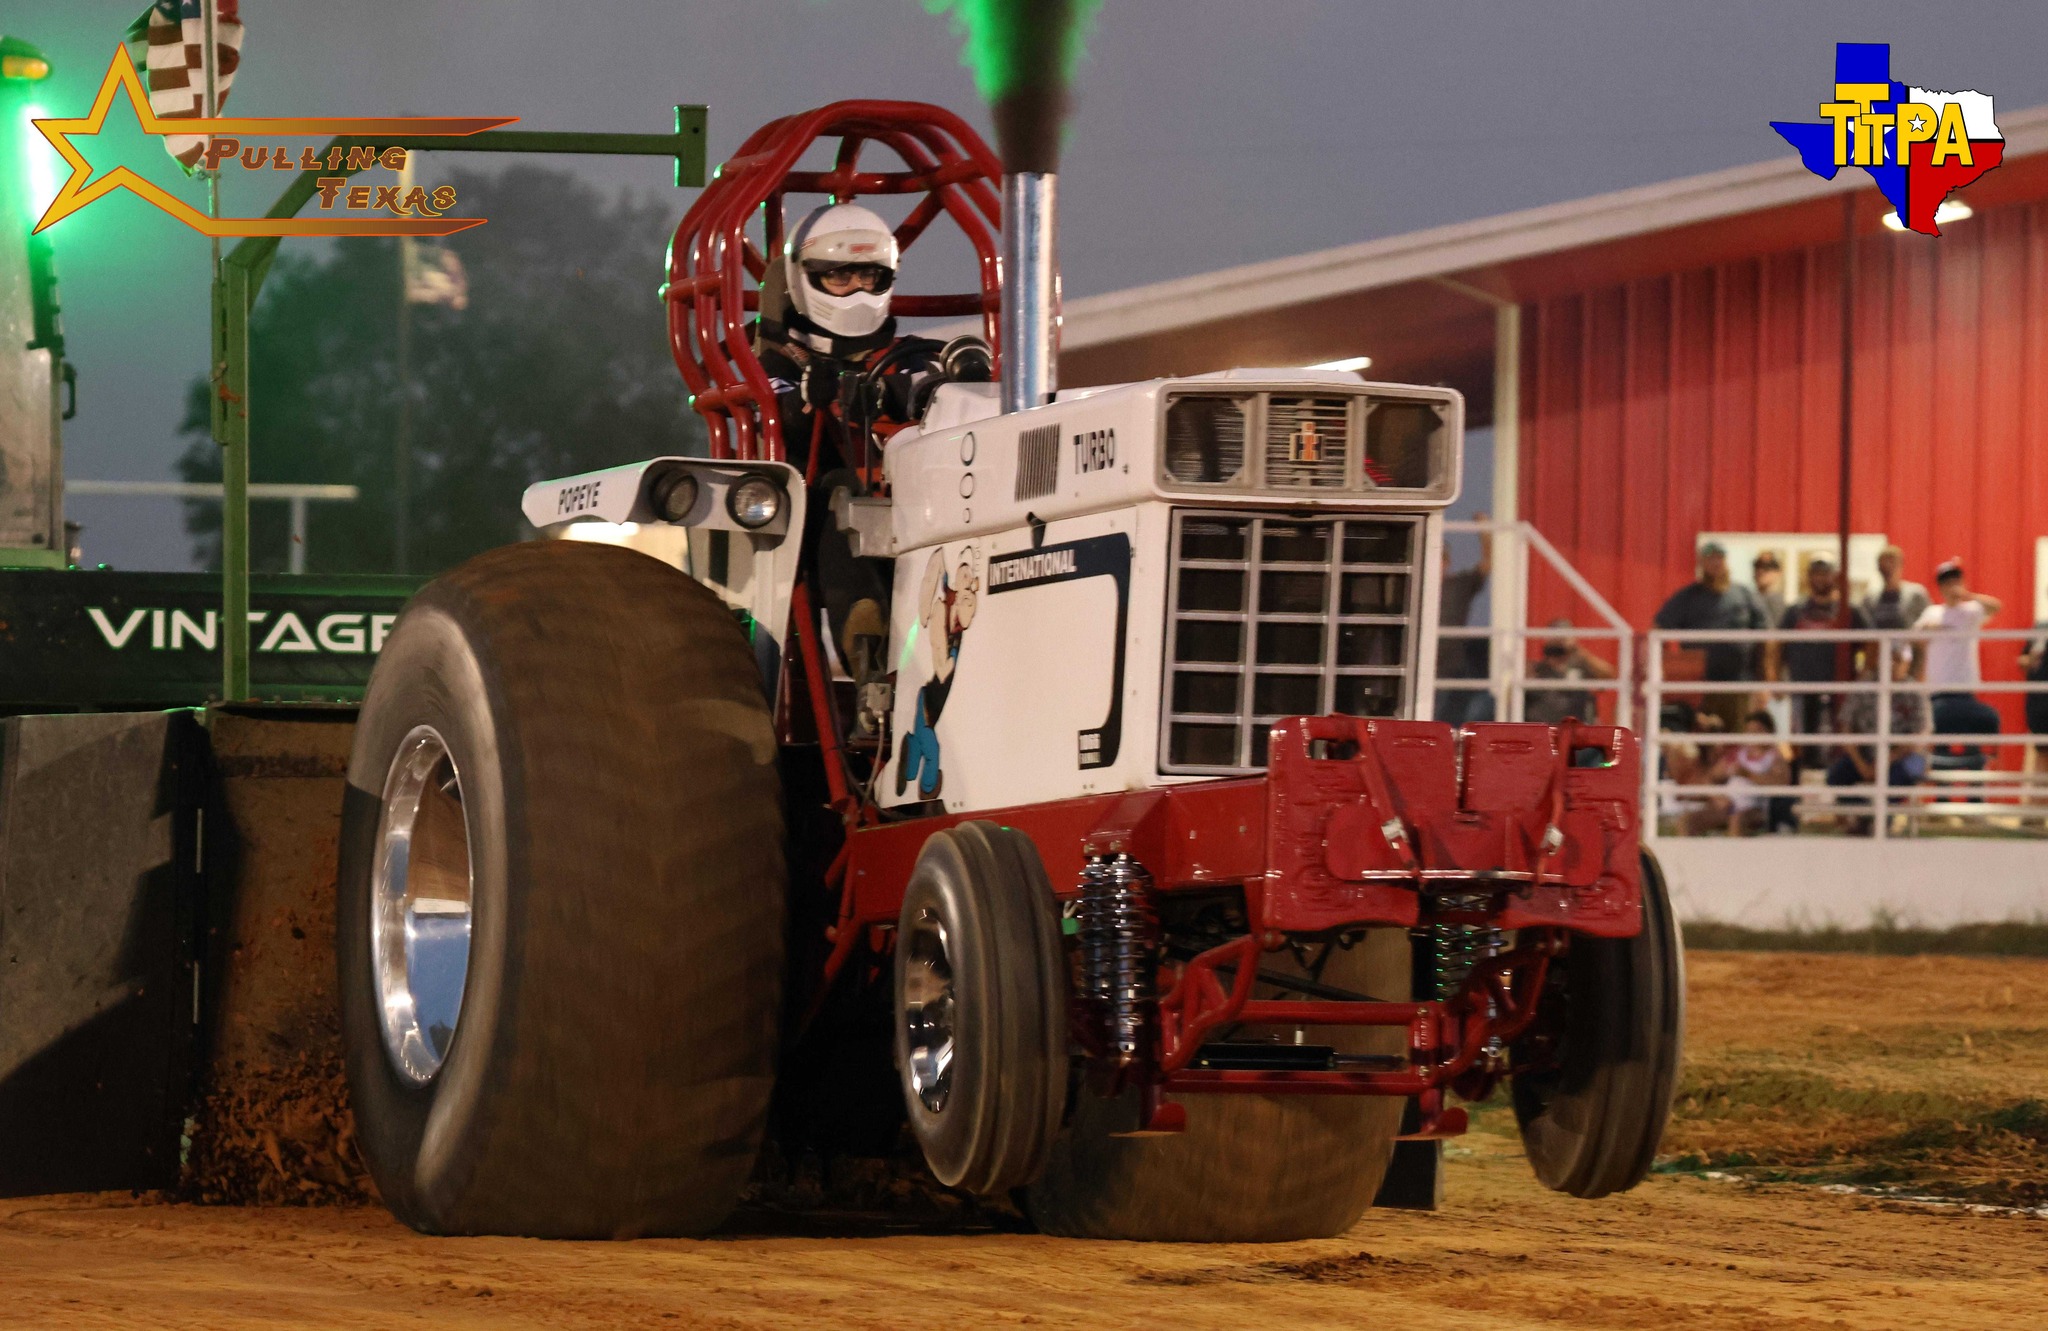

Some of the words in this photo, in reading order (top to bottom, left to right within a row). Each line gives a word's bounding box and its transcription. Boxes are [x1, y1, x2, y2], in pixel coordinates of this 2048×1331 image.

[1073, 428, 1114, 474] TURBO
[558, 481, 601, 515] POPEYE
[989, 549, 1077, 586] INTERNATIONAL
